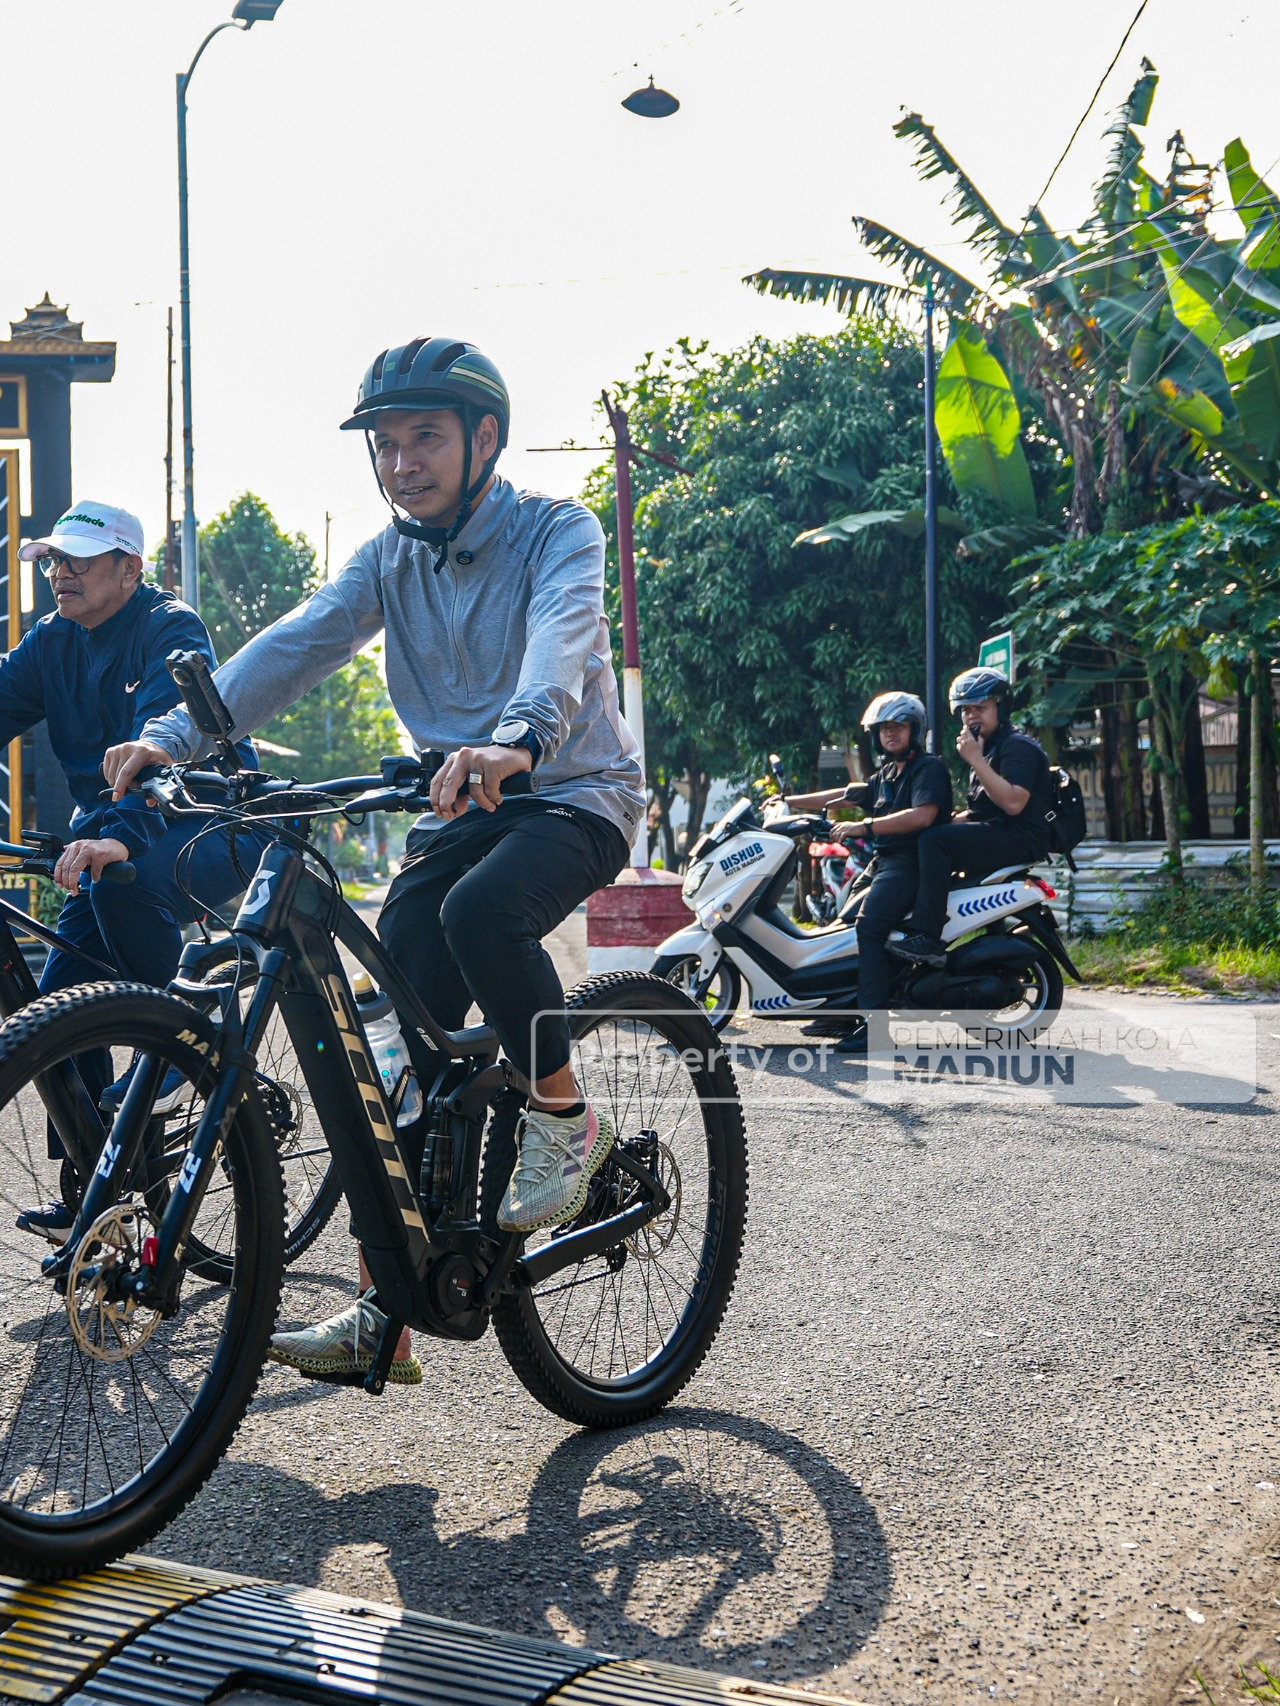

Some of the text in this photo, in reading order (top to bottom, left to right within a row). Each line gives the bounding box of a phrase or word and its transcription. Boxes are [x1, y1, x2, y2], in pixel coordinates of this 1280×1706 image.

[720, 842, 763, 871] DISHUB
[741, 853, 766, 869] MADIUN
[321, 974, 430, 1243] SCOTT
